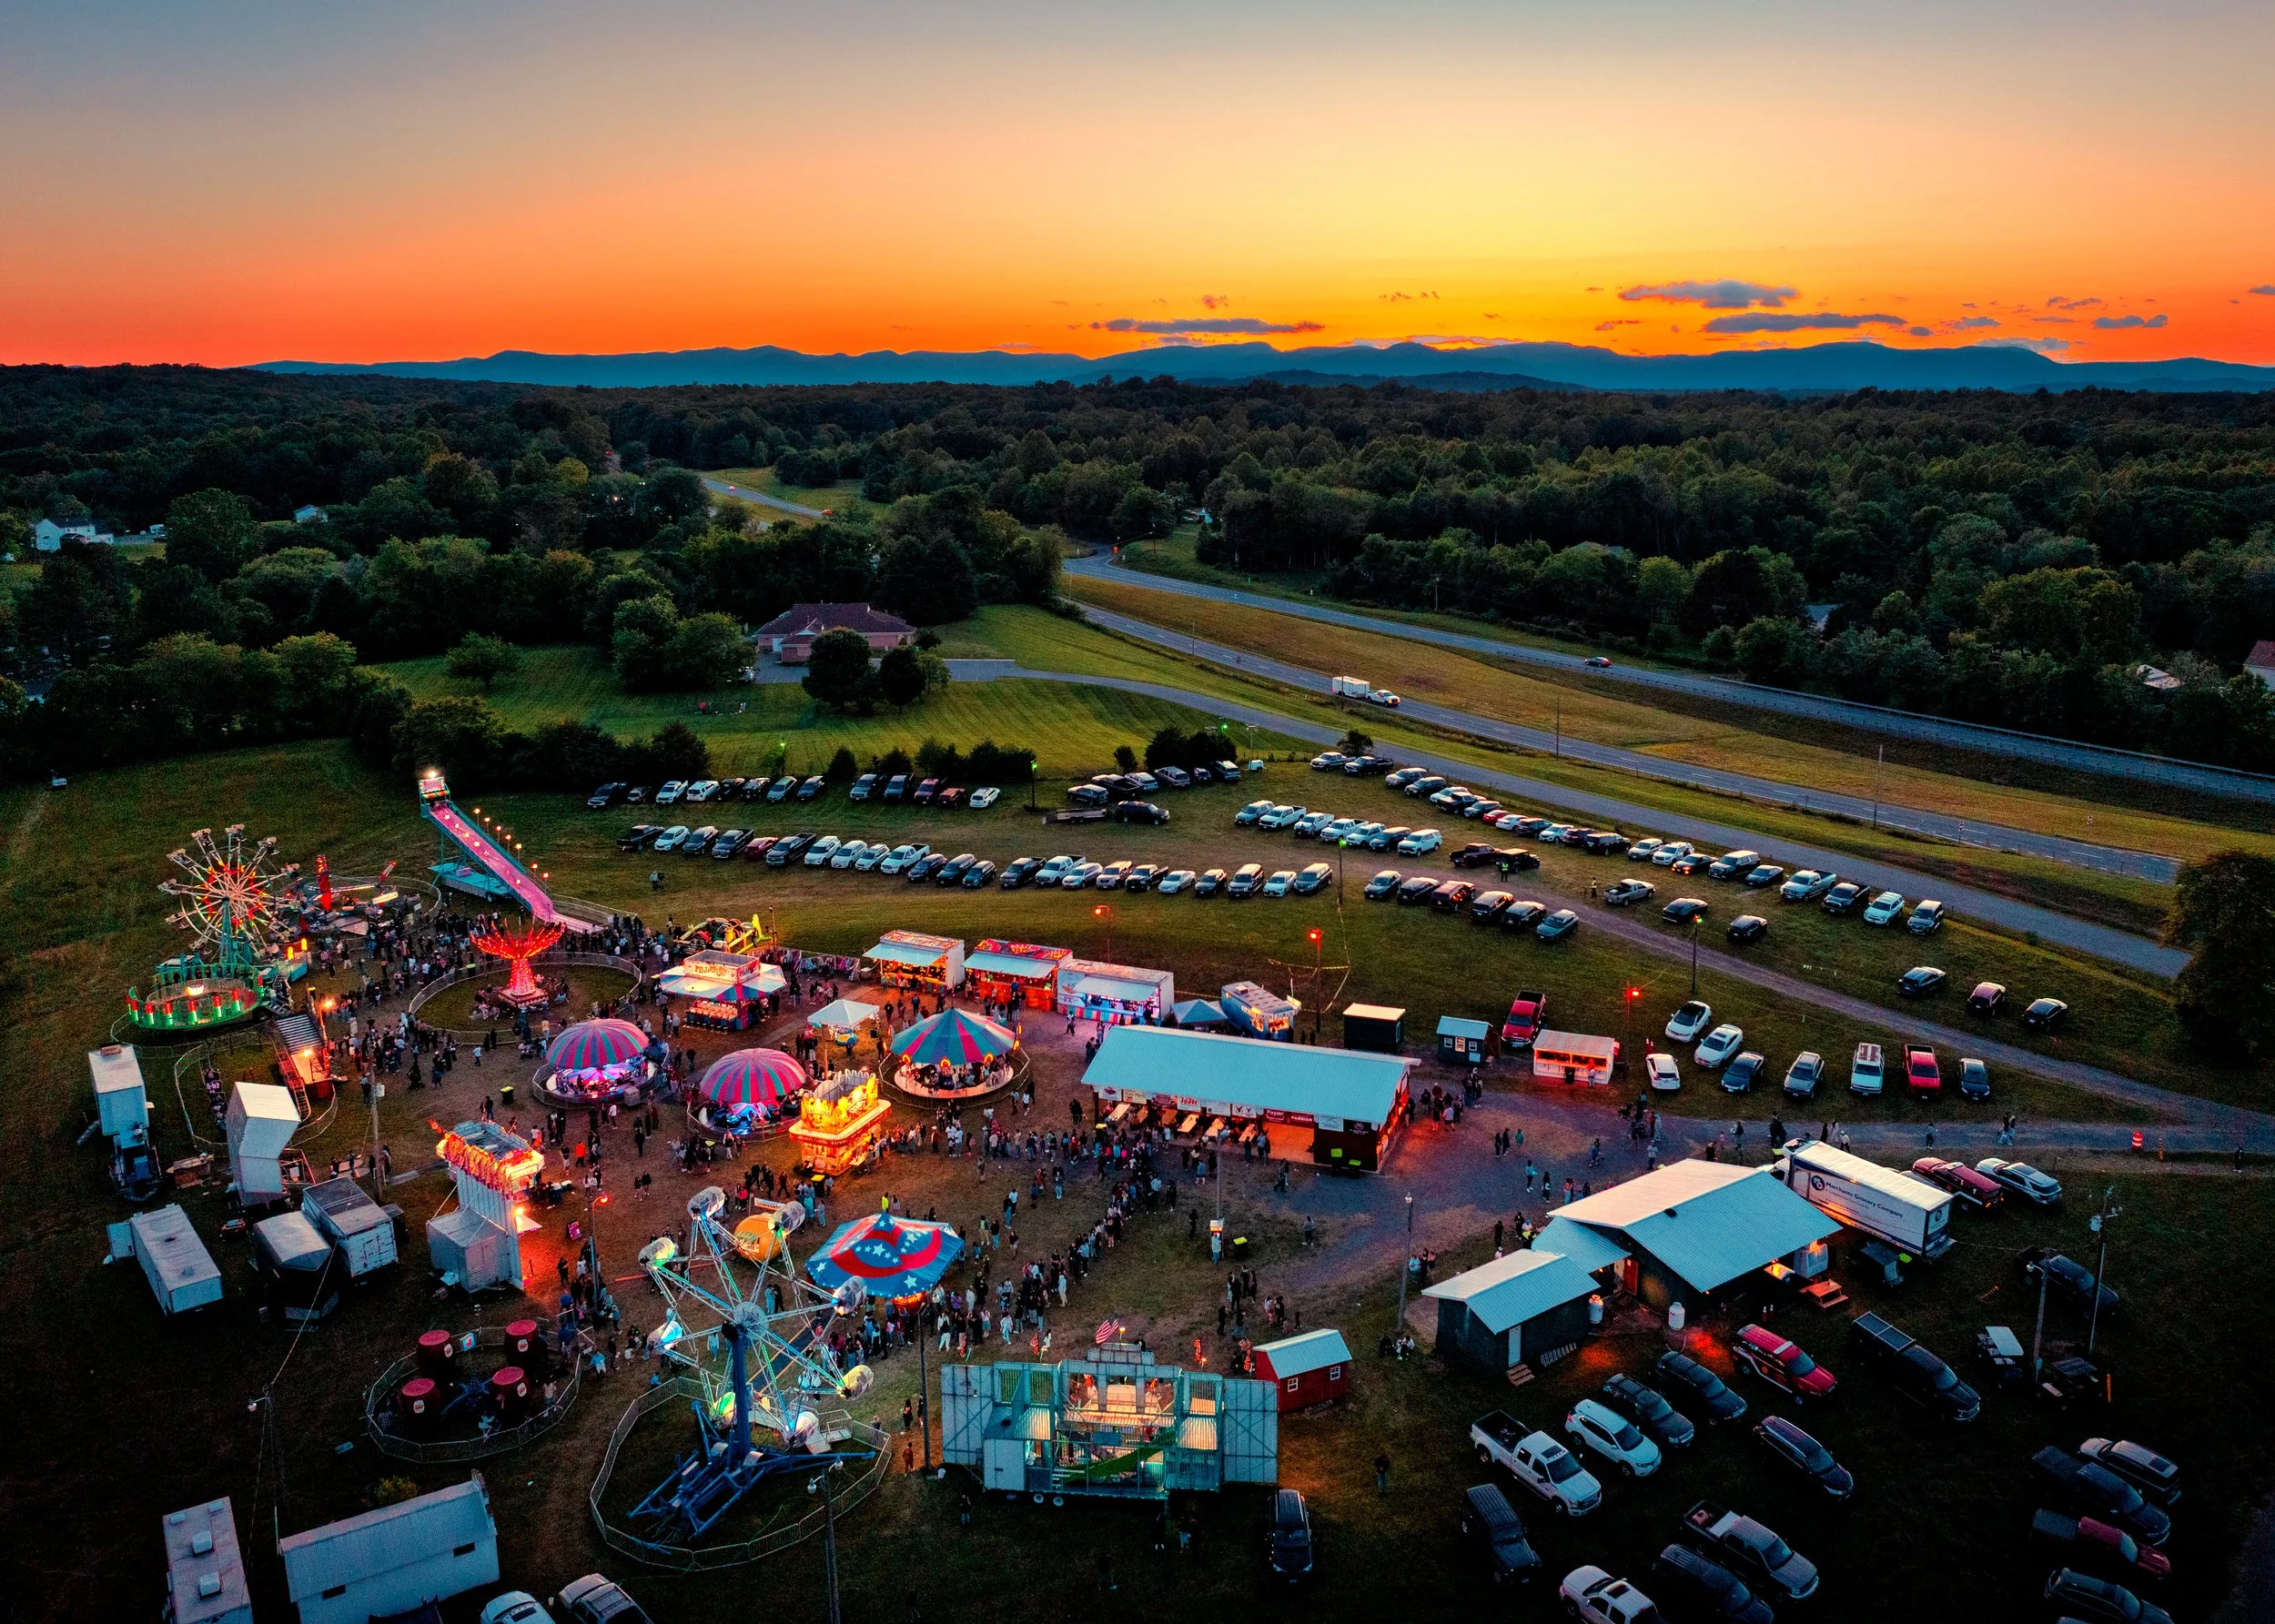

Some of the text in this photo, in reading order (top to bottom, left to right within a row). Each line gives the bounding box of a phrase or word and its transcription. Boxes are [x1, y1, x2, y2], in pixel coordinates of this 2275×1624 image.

[1825, 1181, 1854, 1196] Merchants
[1854, 1193, 1876, 1207] Grocery
[1877, 1204, 1903, 1218] Company
